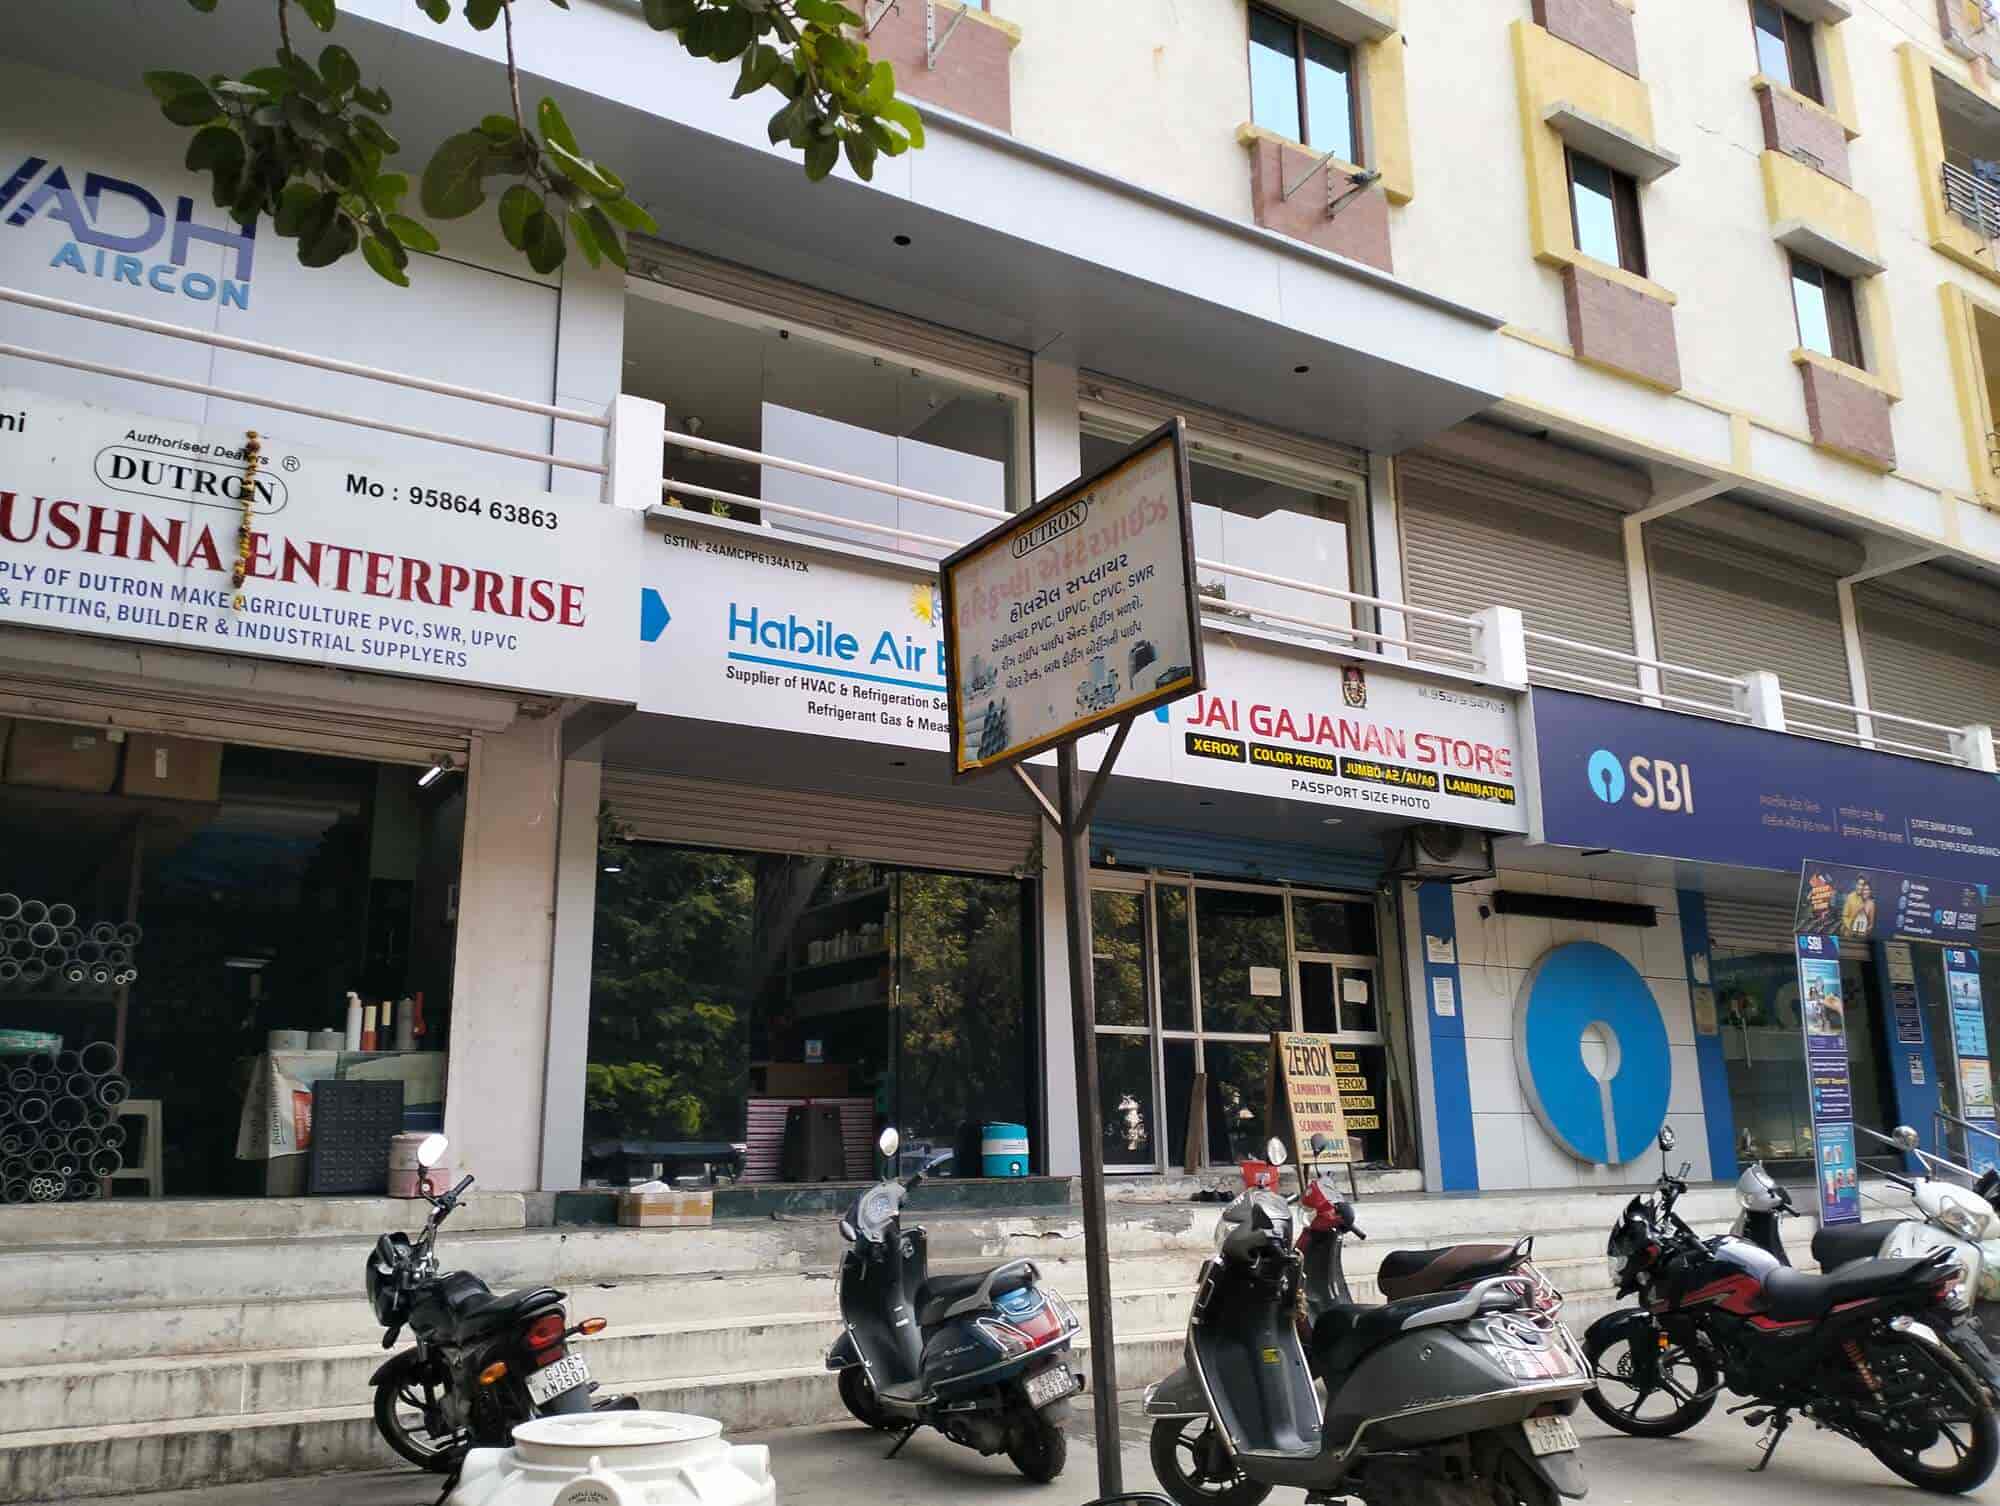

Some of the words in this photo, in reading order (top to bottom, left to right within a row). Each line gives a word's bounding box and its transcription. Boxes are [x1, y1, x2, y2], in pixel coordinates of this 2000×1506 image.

[50, 241, 250, 311] AIRCON
[124, 429, 210, 455] Authorised
[213, 444, 270, 466] Dears
[108, 453, 277, 507] DUTRON
[346, 474, 385, 498] Mo
[409, 486, 482, 517] 95864
[489, 502, 559, 531] 63863
[664, 533, 702, 552] GSTIN:
[1016, 503, 1082, 554] DUTRON
[244, 531, 587, 628] ENTERPRISE
[1009, 587, 1061, 624] હોલસેલ
[1065, 553, 1129, 595] સપ્લાયર
[1128, 564, 1155, 588] SWR
[20, 590, 111, 622] FITTING,
[117, 604, 208, 633] BUILDER
[215, 618, 229, 635] &
[237, 620, 356, 653] INDUSTRIAL
[362, 638, 468, 668] SUPPLYERS
[44, 567, 71, 587] OF
[79, 572, 163, 600] DUTRON
[171, 584, 231, 610] MAKE
[235, 595, 372, 630] AGRICULTURE
[472, 629, 518, 651] UPVC
[728, 602, 859, 661] Habile
[870, 630, 927, 673] Air
[726, 665, 780, 688] Supplier
[784, 676, 798, 689] of
[801, 676, 836, 695] HVAC
[840, 683, 848, 697] &
[852, 685, 930, 710] Refrigeration
[808, 701, 877, 724] Refrigerant
[880, 711, 902, 728] Gas
[906, 715, 914, 728] &
[1187, 694, 1239, 731] JAI
[1249, 703, 1407, 760] GAJANAN
[1414, 732, 1513, 778] STORE
[1194, 738, 1239, 757] XEROX
[1253, 747, 1294, 766] COLOR
[1295, 754, 1334, 771] XEROX
[1344, 761, 1382, 780] JUMBO
[1446, 779, 1514, 802] LAMINATION
[1629, 755, 1694, 815] SBI
[1291, 778, 1359, 800] PASSPORT
[1362, 789, 1389, 803] SIZE
[1391, 794, 1431, 809] PHOTO
[1285, 1046, 1331, 1077] ZEROX
[1336, 1077, 1365, 1090] EROX
